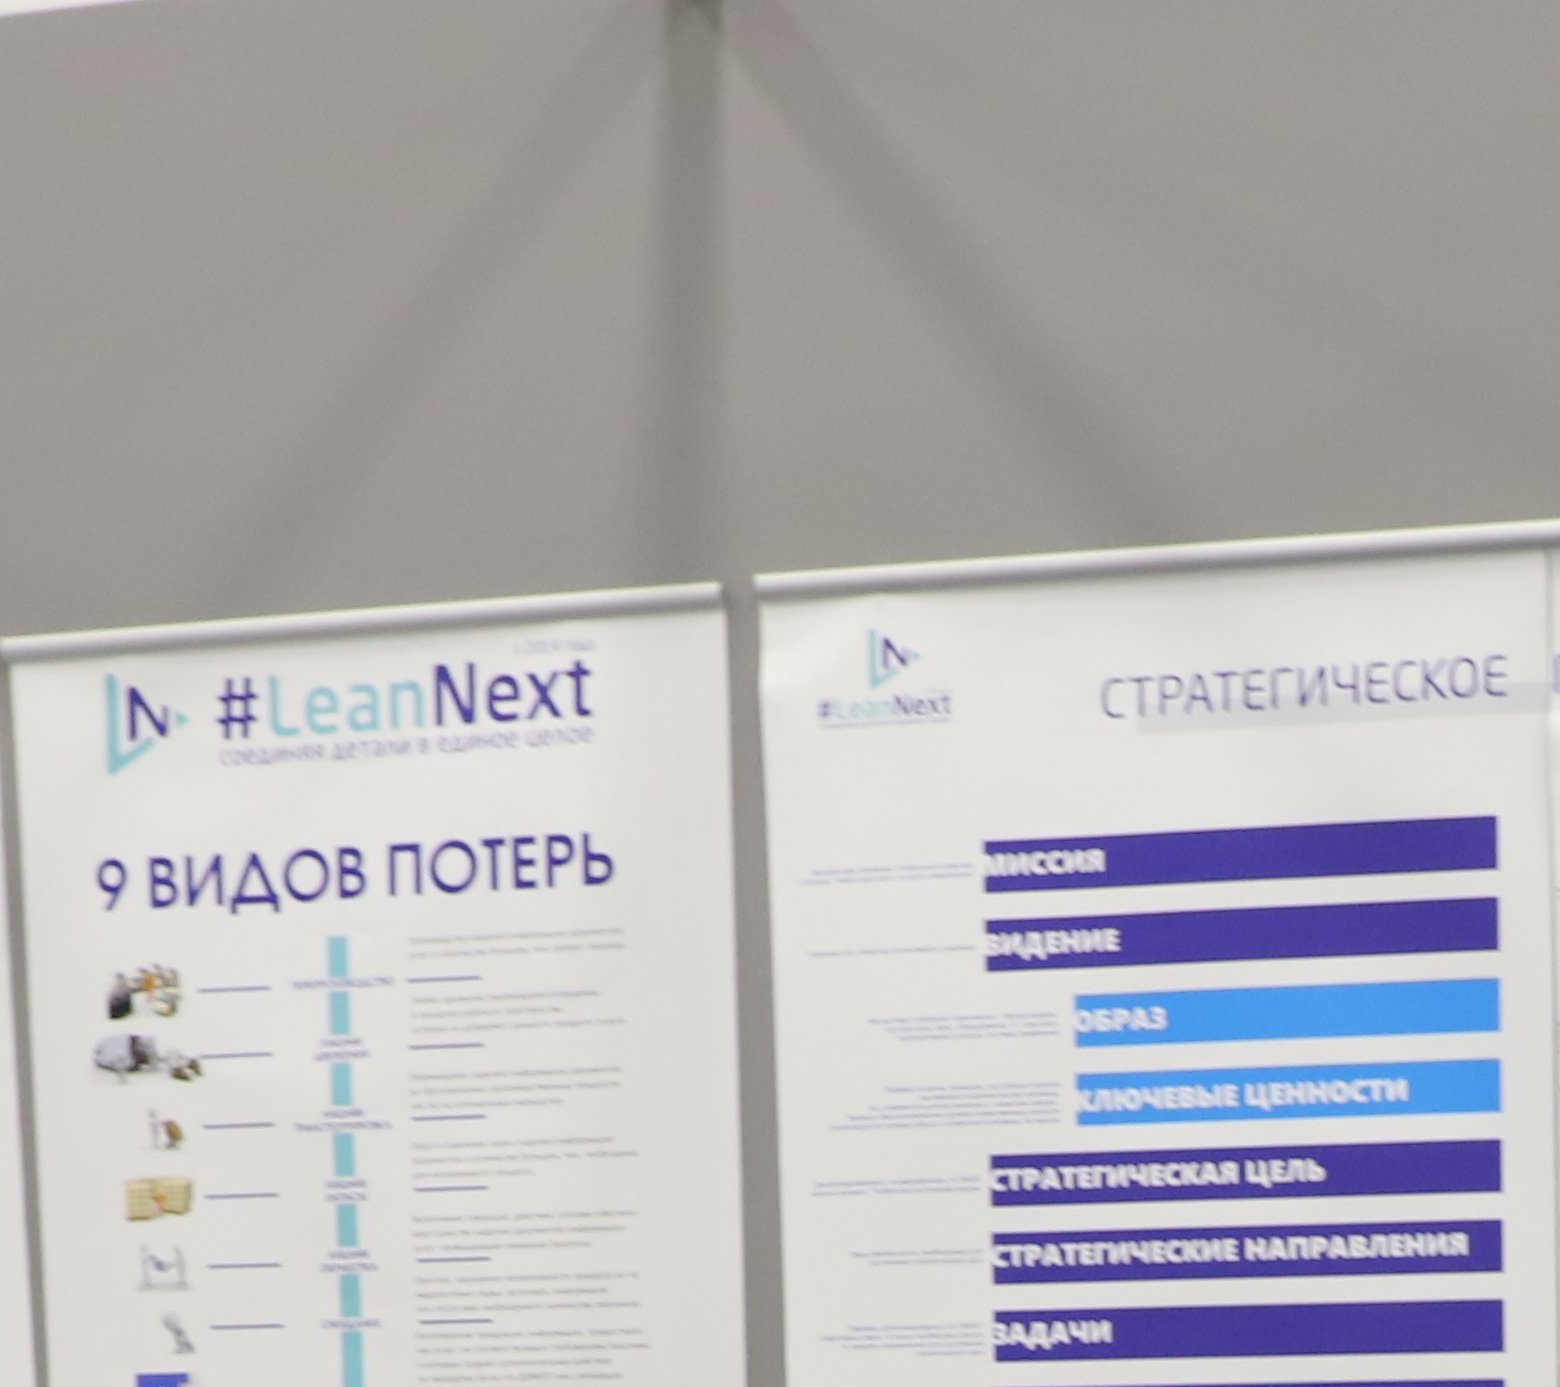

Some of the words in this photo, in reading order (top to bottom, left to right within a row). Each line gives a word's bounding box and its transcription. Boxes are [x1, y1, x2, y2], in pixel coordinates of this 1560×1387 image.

[216, 659, 593, 740] #LeanNext
[1099, 654, 1508, 719] СТРАТЕГИЧЕСКОЕ
[96, 857, 127, 912] 9
[147, 844, 368, 915] ВИДОВ
[387, 832, 616, 897] ПОТЕРЬ
[1075, 1006, 1169, 1034] ОБРАЗ
[1075, 1083, 1239, 1113] КЛЮЧЕВЫЕ
[1245, 1078, 1410, 1112] ЦЕННОСТИ
[989, 1159, 1240, 1193] СТРАТЕГИЧЕСКАЯ
[1245, 1156, 1328, 1188] ЦЕЛЬ
[991, 1237, 1240, 1270] СТРАТЕГИЧЕСКИЕ
[1244, 1231, 1470, 1262] НАПРАВЛЕНИЯ
[992, 1319, 1114, 1351] ЗАДАЧИ
